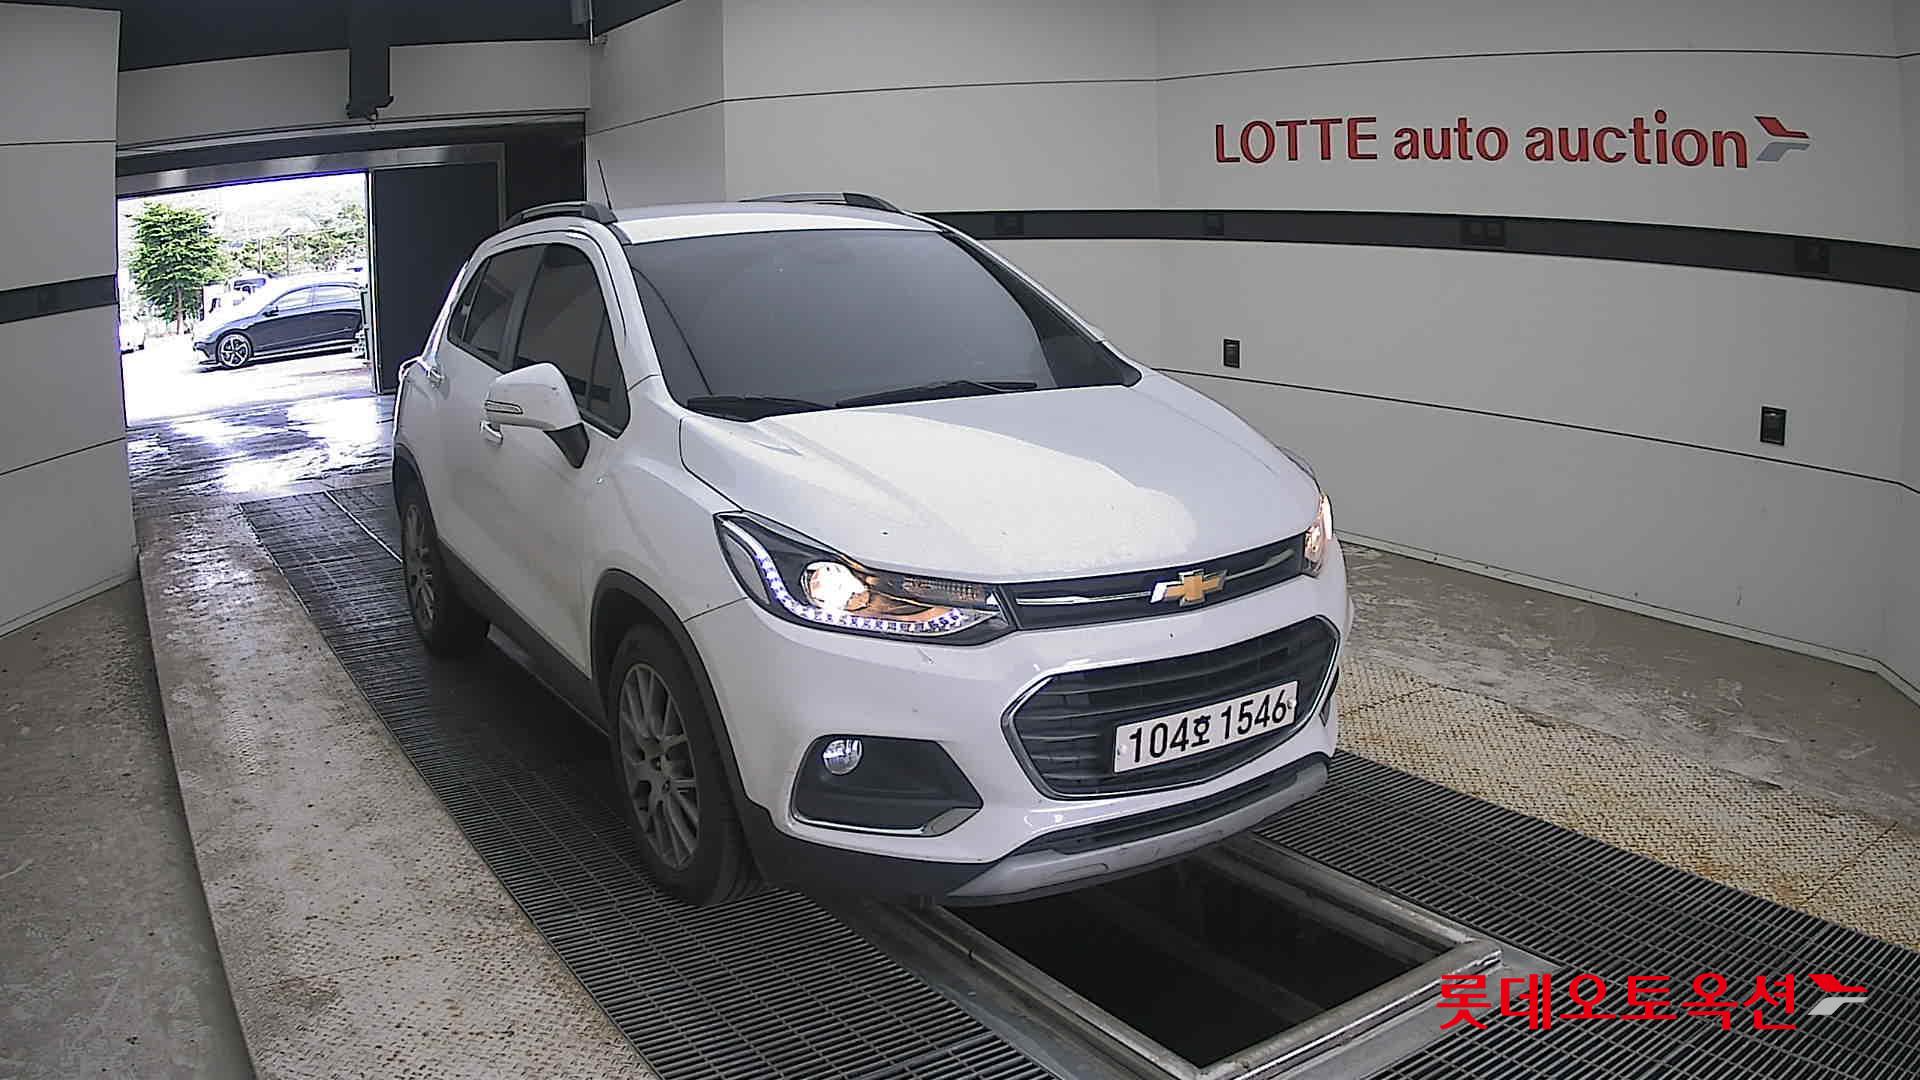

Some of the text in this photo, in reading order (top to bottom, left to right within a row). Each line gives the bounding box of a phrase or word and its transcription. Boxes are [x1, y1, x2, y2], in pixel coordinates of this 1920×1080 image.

[1215, 109, 1748, 169] LOTTE auto auction
[1129, 689, 1288, 763] 104호 1546
